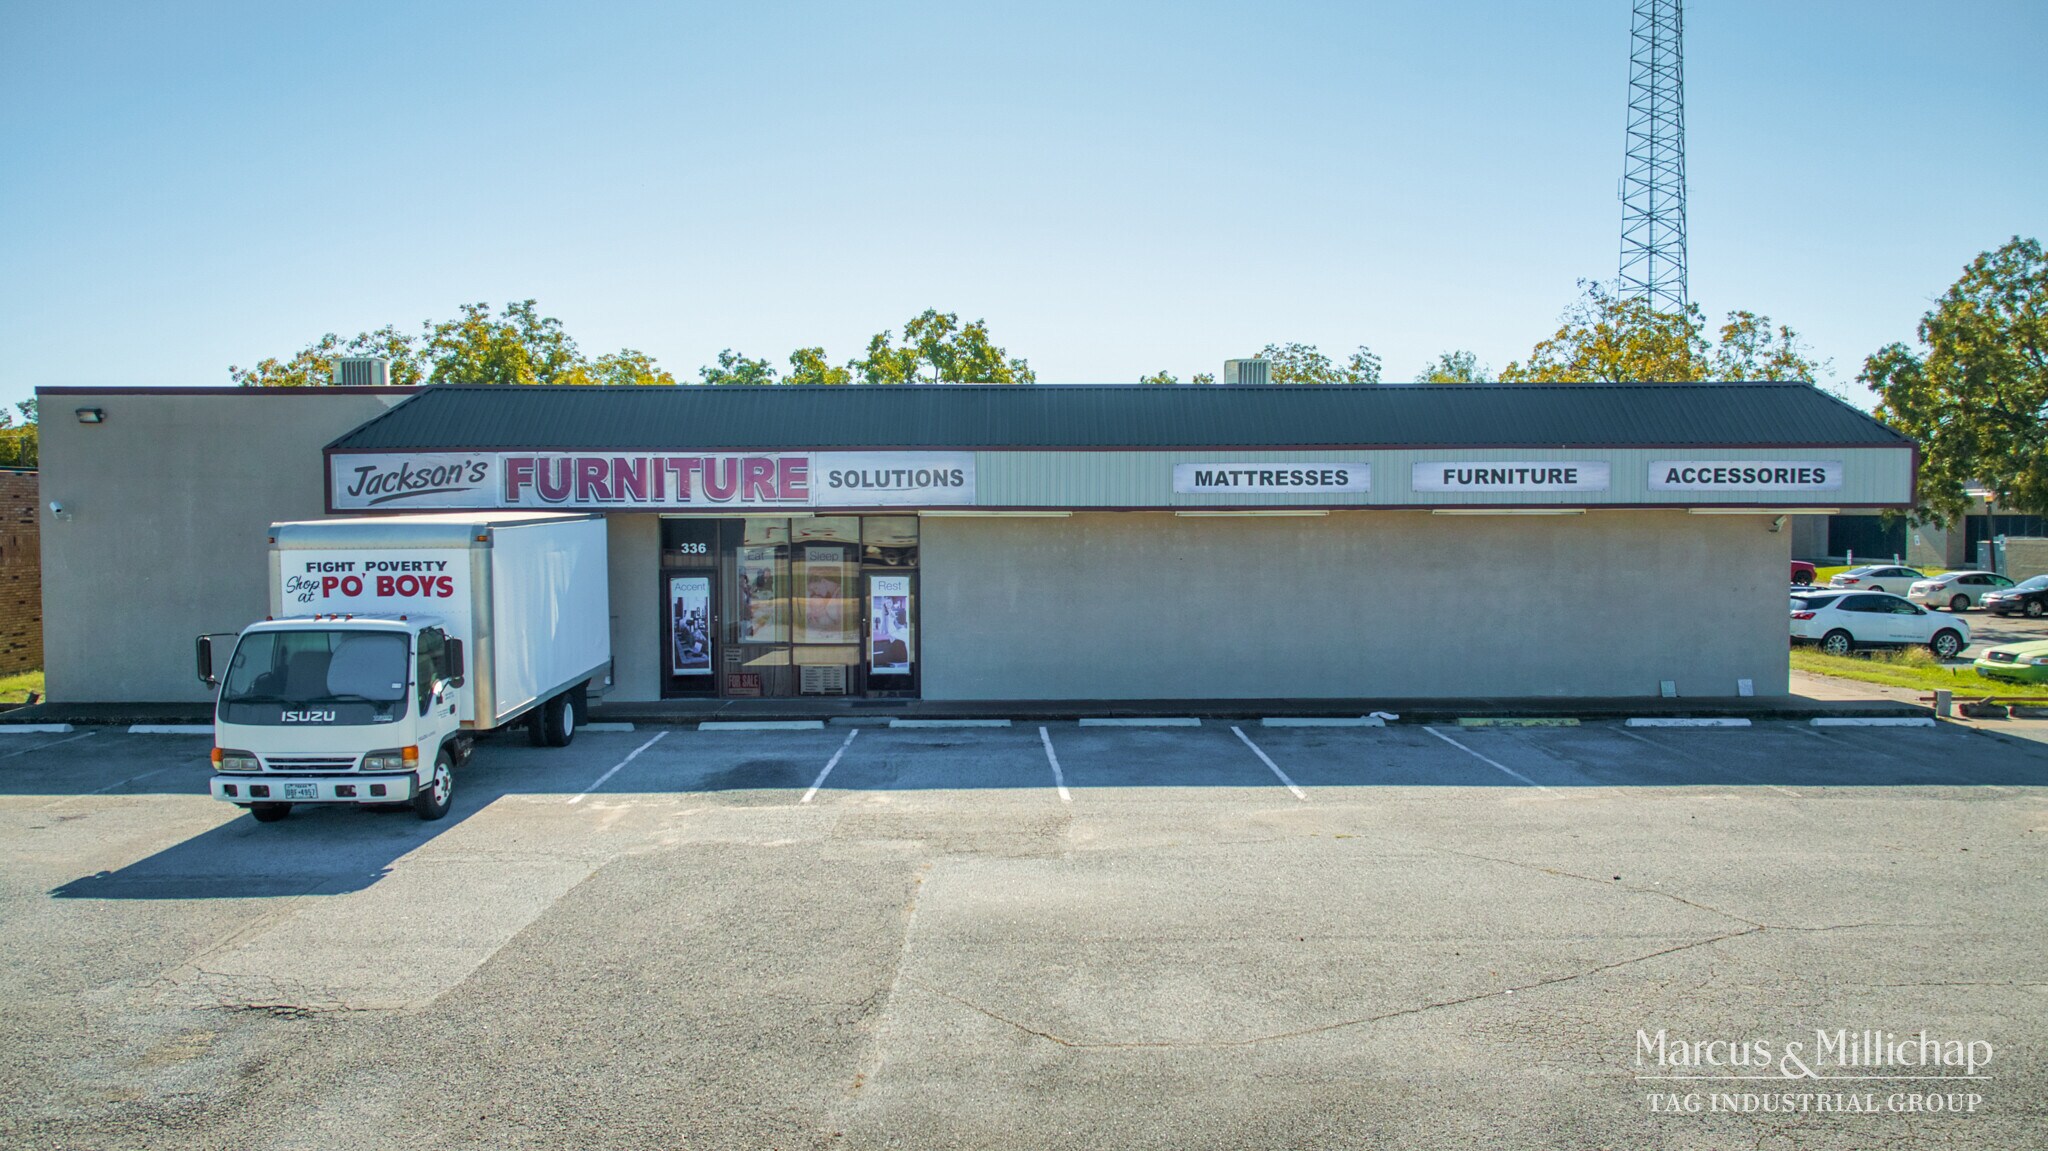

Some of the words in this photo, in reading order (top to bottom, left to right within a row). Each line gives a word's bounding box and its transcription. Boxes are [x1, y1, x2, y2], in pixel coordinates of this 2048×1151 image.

[347, 459, 488, 498] Jackson's
[505, 457, 809, 503] FURNITURE
[828, 468, 964, 489] SOLUTIONS
[1194, 469, 1350, 487] MATTRESSES
[1443, 468, 1578, 485] FURNITURE
[1665, 467, 1827, 484] ACCESSORIES
[681, 542, 707, 554] 336
[747, 551, 765, 561] Eat
[809, 550, 839, 563] Sleep
[305, 561, 356, 573] FIGHT
[365, 560, 448, 572] POVERTY
[286, 575, 321, 594] Shop
[321, 572, 367, 598] PO'
[376, 574, 455, 598] BOYS
[674, 582, 707, 592] Accent
[878, 580, 902, 591] Rest
[297, 592, 316, 603] at
[728, 674, 741, 688] FOR
[742, 674, 759, 688] SALE
[281, 711, 337, 722] ISUZU
